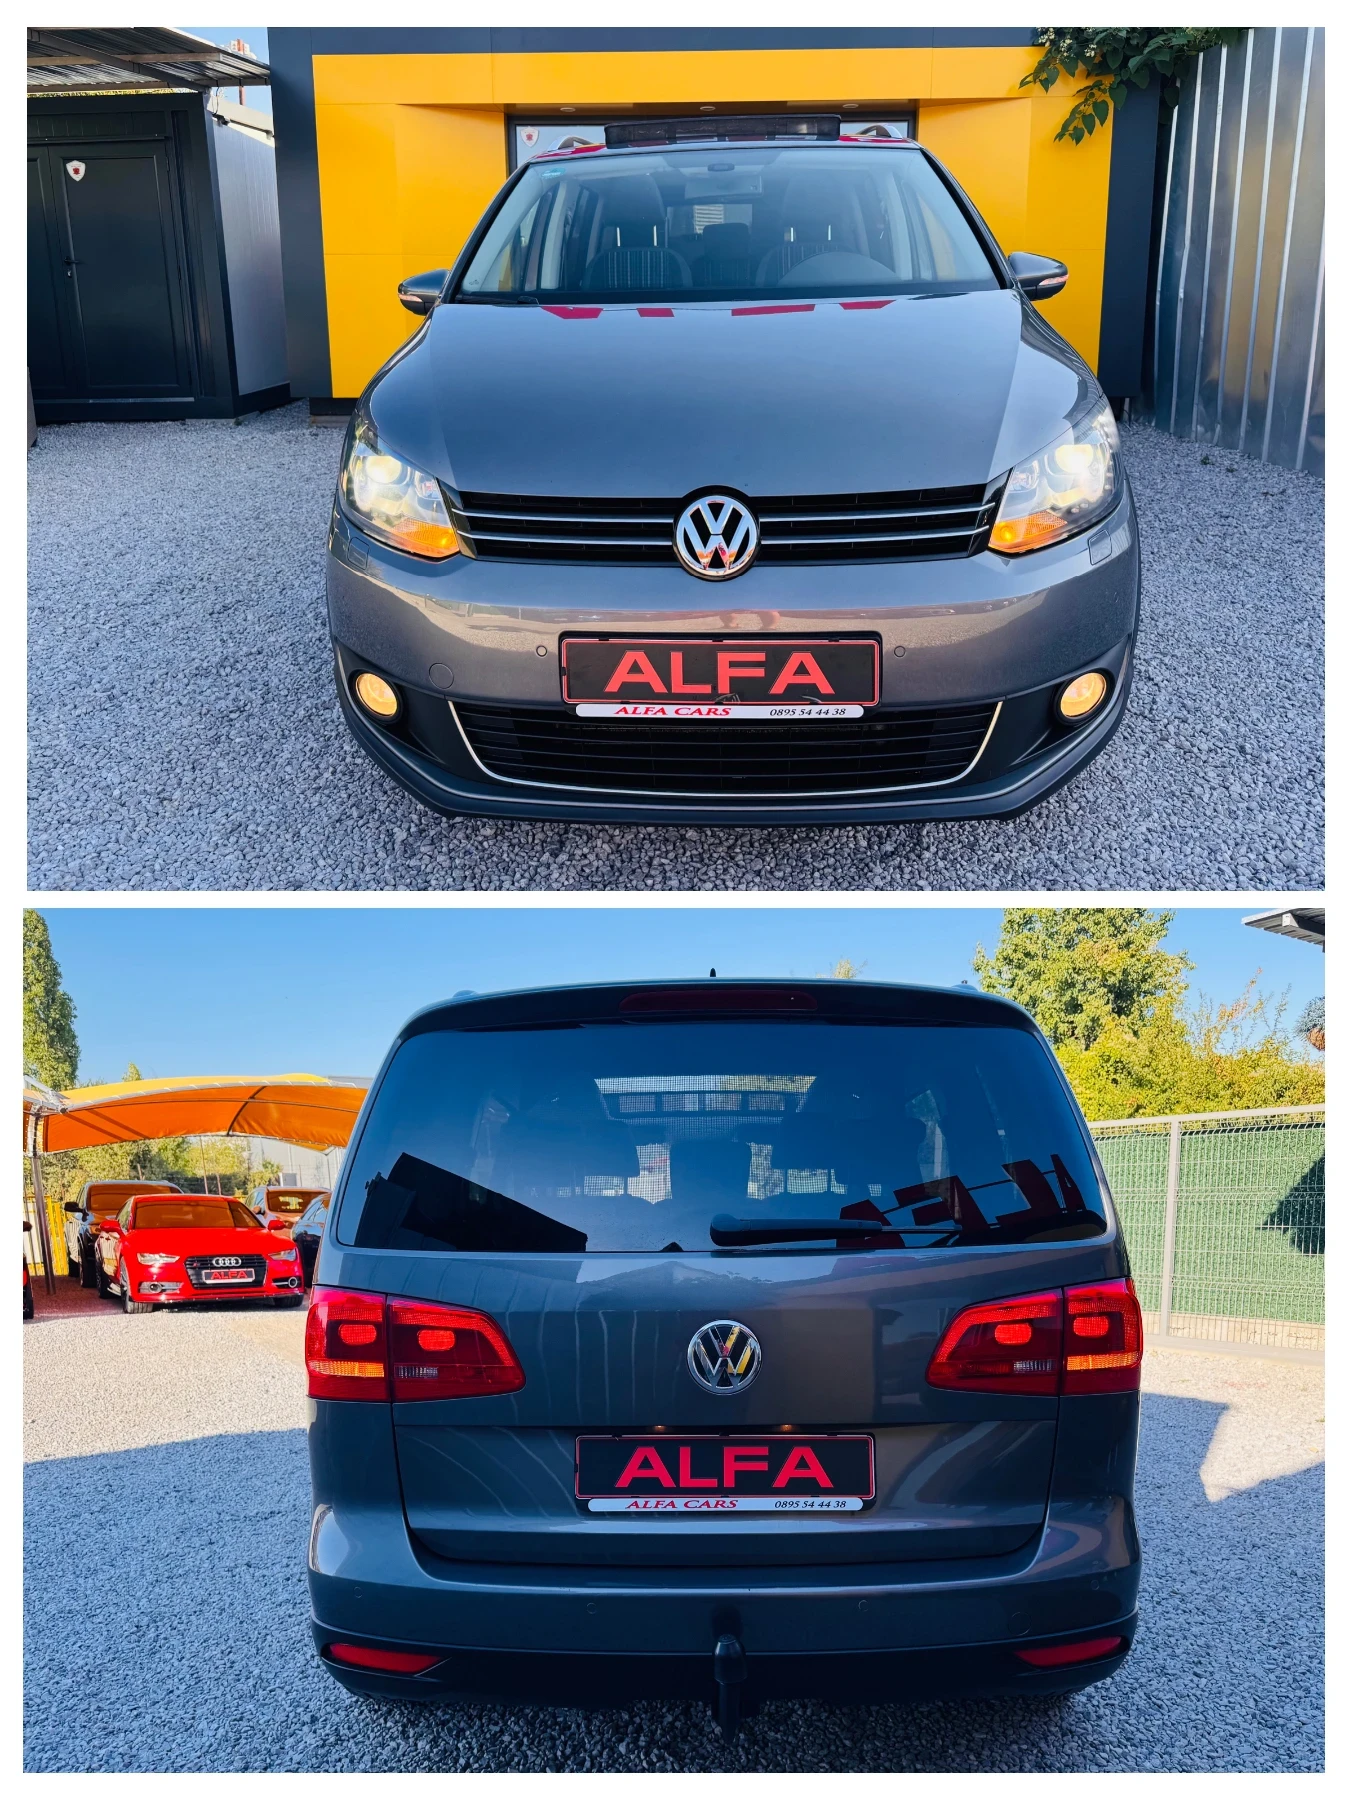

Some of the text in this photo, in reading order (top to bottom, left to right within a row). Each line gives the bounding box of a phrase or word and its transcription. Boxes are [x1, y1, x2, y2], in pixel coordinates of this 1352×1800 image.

[677, 495, 757, 575] VW
[603, 650, 836, 695] ALFA
[614, 706, 732, 716] ALFA CARS
[769, 708, 846, 717] 0895 54 44 38
[211, 1270, 248, 1280] ALFA
[688, 1320, 761, 1394] VW
[614, 1446, 834, 1488] ALFA
[625, 1500, 739, 1509] ALFA CARS
[774, 1500, 847, 1509] 0895 54 44 38
